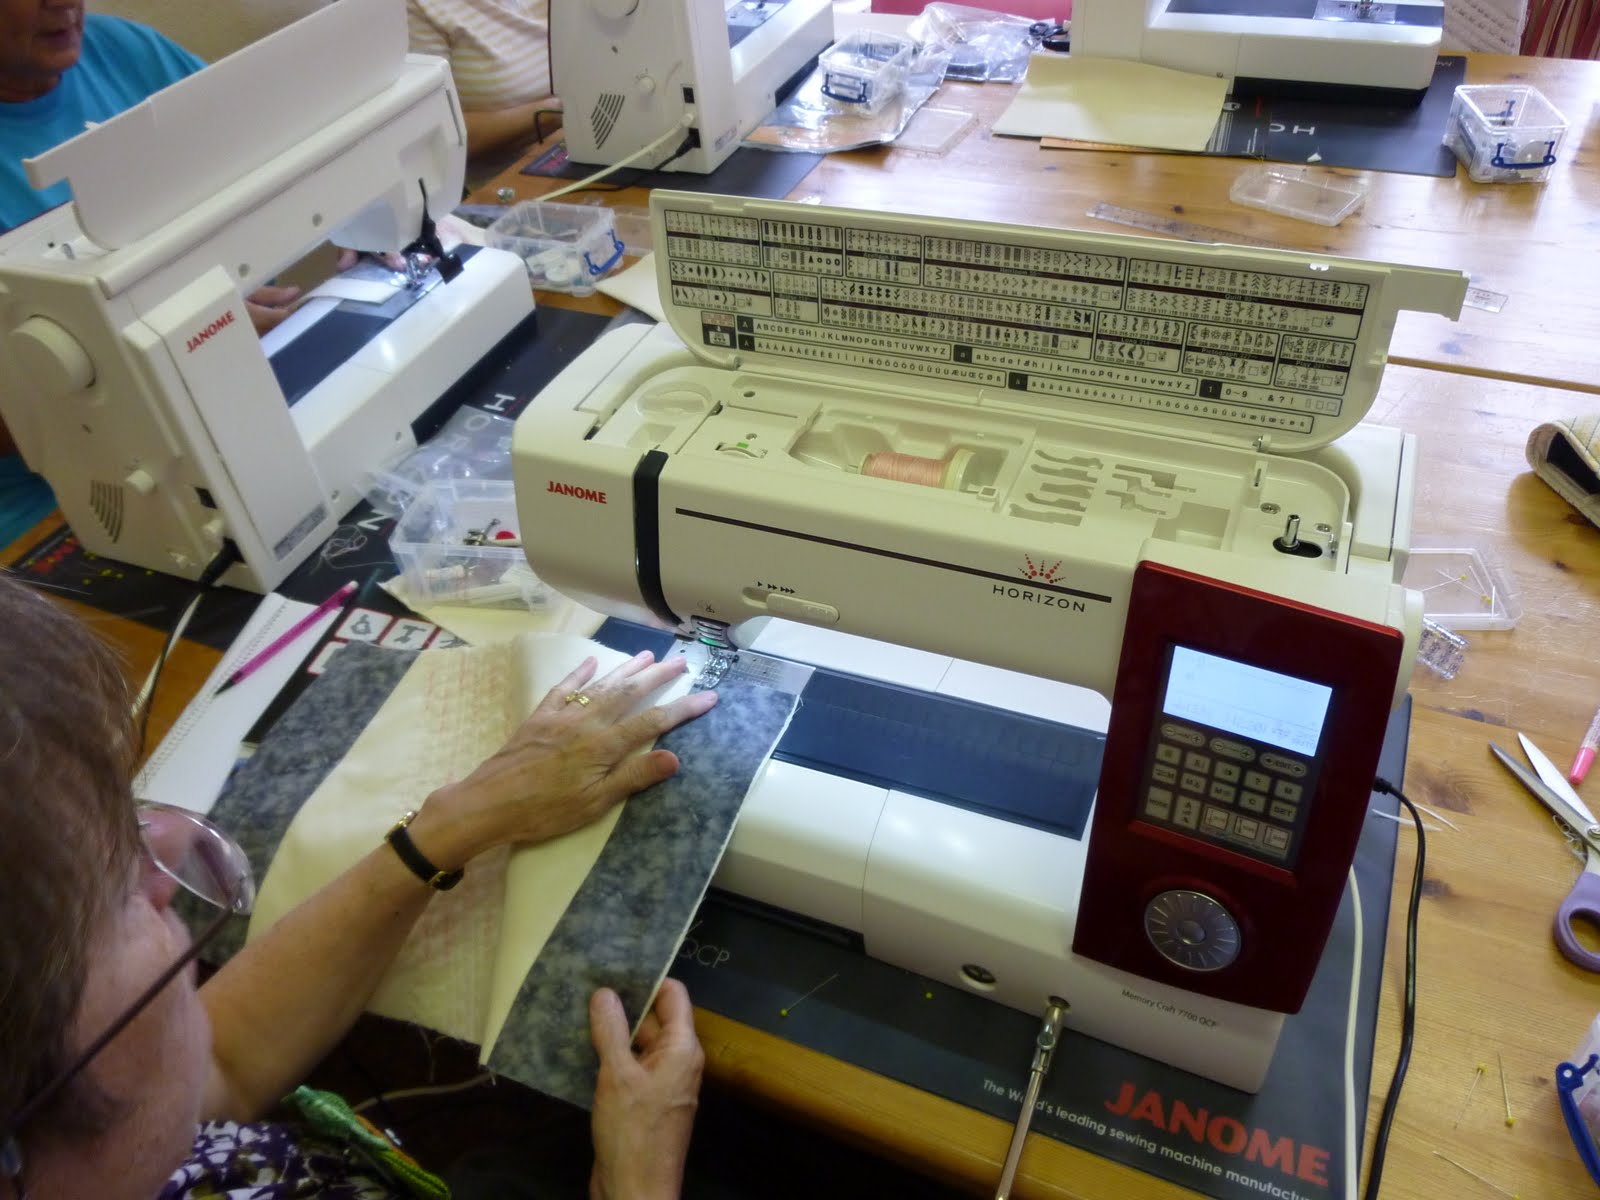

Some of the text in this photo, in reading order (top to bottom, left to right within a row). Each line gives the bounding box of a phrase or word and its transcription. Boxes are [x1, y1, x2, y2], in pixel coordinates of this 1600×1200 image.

[186, 310, 235, 354] JANOME
[547, 481, 607, 504] JANOME
[993, 585, 1085, 612] HORIZON
[679, 937, 730, 968] QCP
[1122, 988, 1154, 1008] Memory
[1156, 1001, 1176, 1015] Craft
[1177, 1009, 1198, 1022] 7700
[983, 1079, 1312, 1200] The Wd's leading sewing machine manufactu
[1104, 1082, 1330, 1188] JANOME
